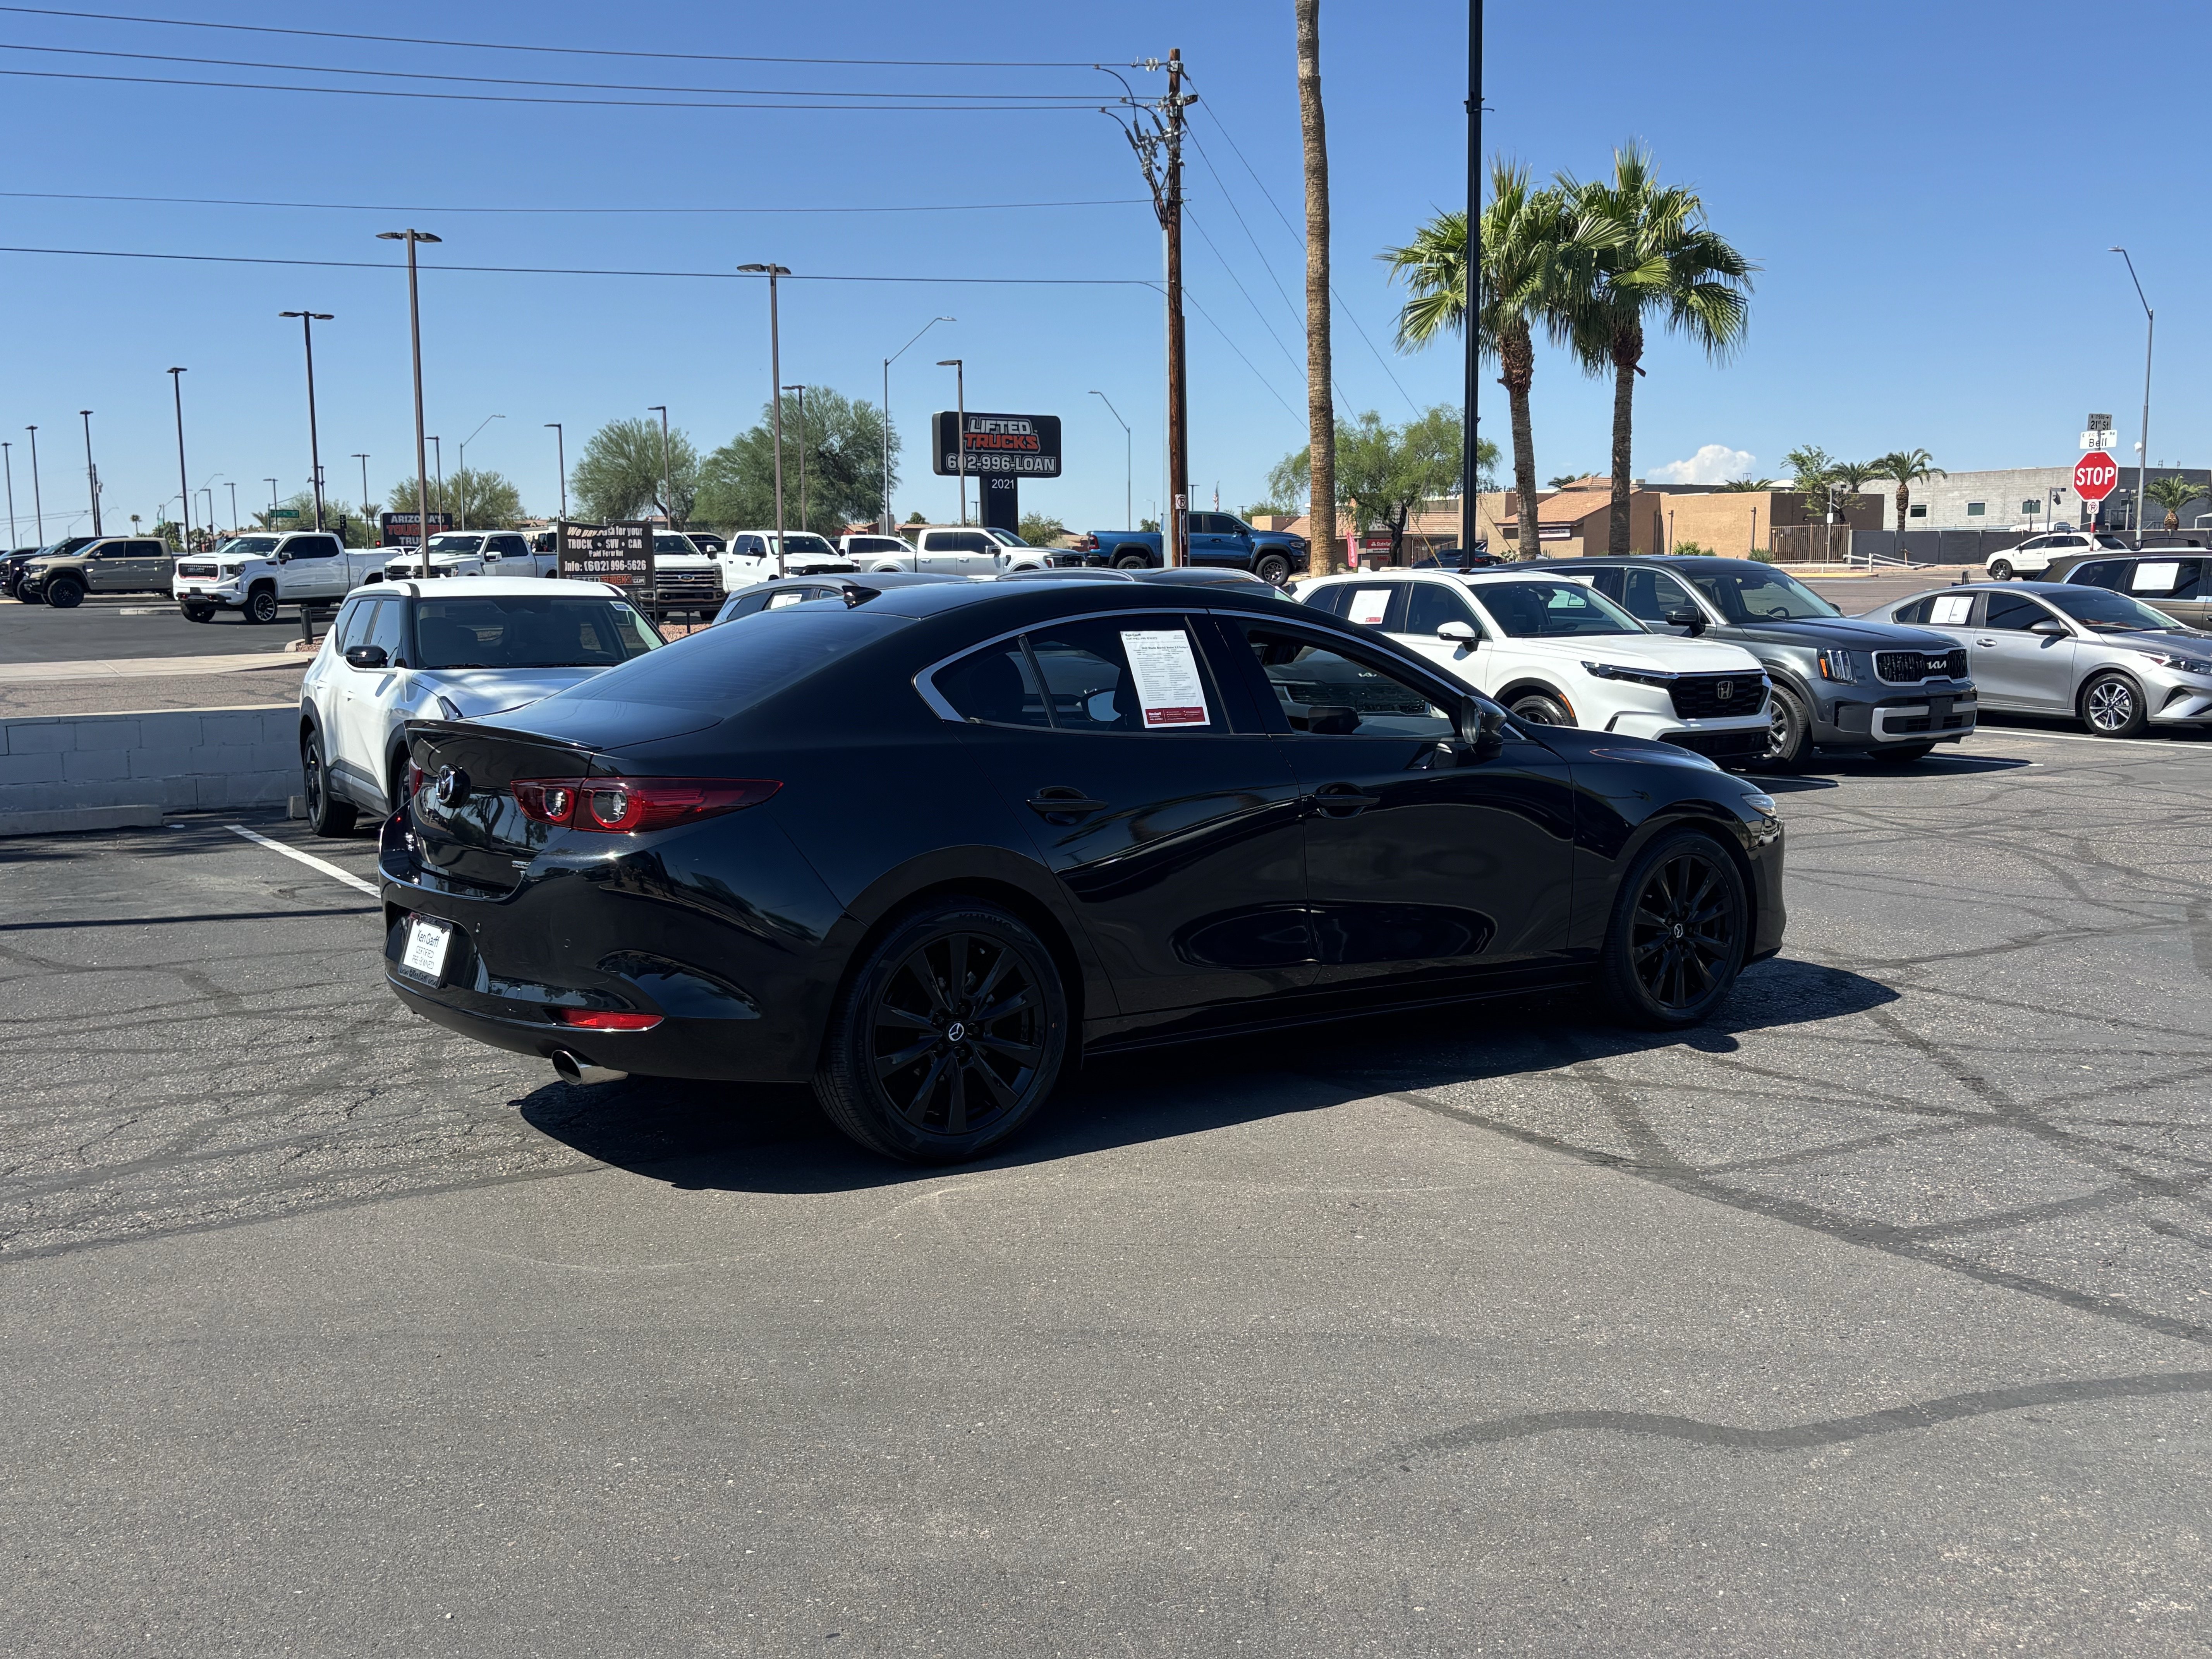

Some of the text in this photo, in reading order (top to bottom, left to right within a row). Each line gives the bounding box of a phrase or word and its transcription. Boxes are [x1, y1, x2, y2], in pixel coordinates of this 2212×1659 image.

[969, 419, 1031, 434] LIFTED
[2102, 421, 2109, 430] St
[964, 433, 1039, 450] TRUCKS
[2089, 438, 2107, 447] Bell
[947, 455, 1054, 471] 602-996-LOAN
[2076, 467, 2114, 486] STOP
[992, 479, 1014, 489] 2021
[386, 524, 449, 535] TOUGEST
[567, 526, 581, 536] We
[616, 526, 626, 535] for
[627, 527, 642, 537] your
[568, 539, 642, 549] TRUCK SUV CAR
[565, 560, 646, 572] Info: (602) 996-5626
[417, 929, 426, 943] Ken
